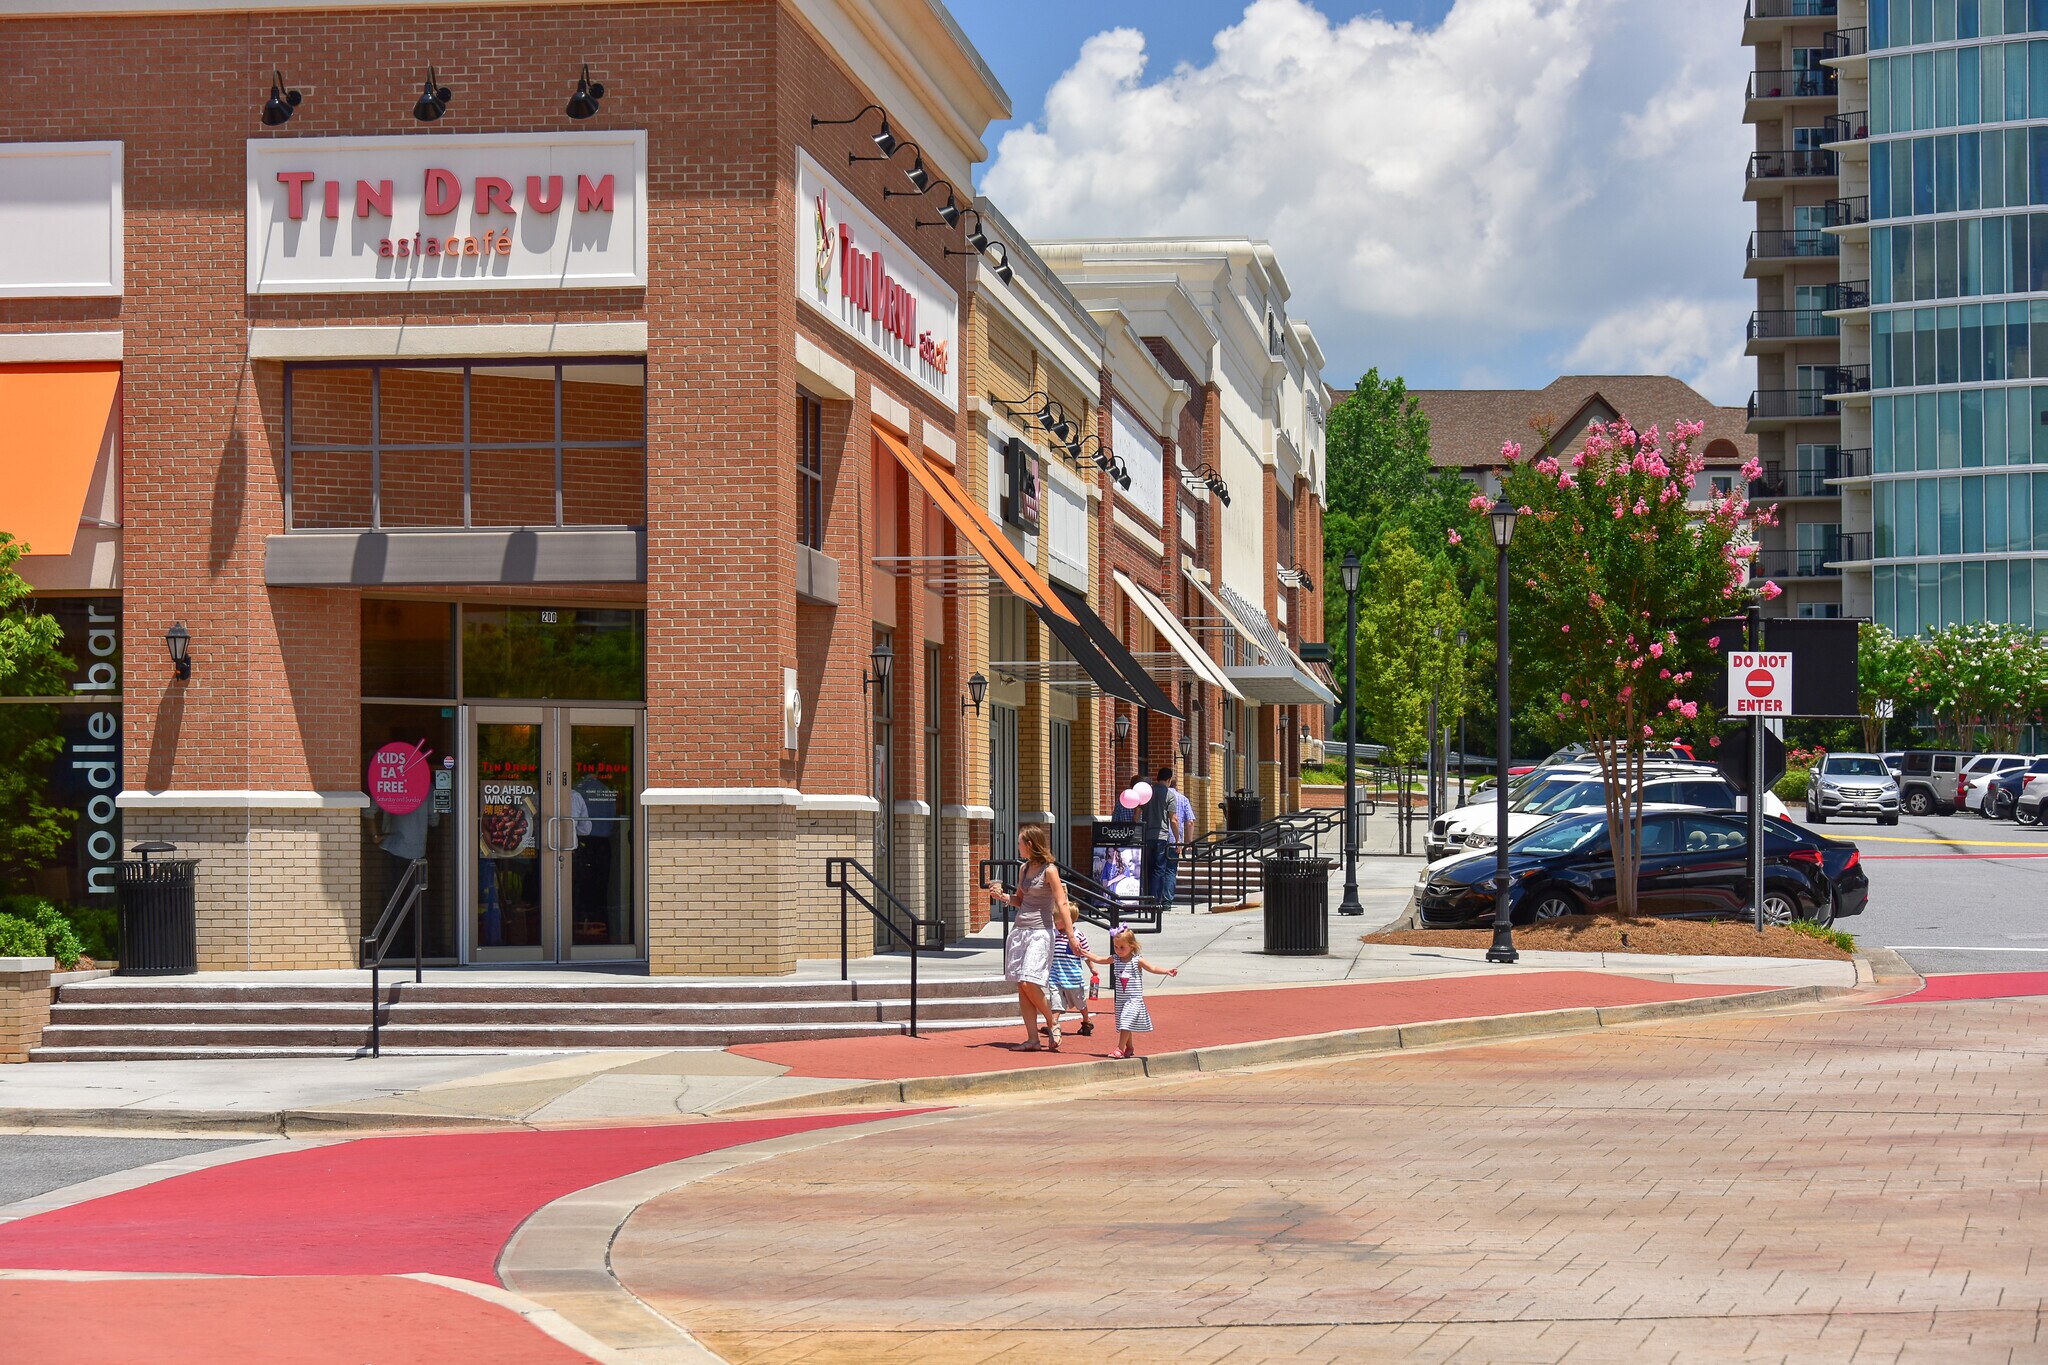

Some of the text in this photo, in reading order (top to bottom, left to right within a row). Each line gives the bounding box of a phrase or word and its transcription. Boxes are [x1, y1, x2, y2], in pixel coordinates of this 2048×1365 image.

[277, 168, 615, 220] TIN DRUM
[541, 611, 557, 623] 200
[1733, 655, 1788, 668] DO NOT
[1737, 699, 1783, 712] ENTER
[72, 605, 117, 893] noodle bar
[377, 752, 406, 765] KIDS
[484, 785, 536, 796] GO AHEAD.
[484, 795, 523, 805] WING IT.
